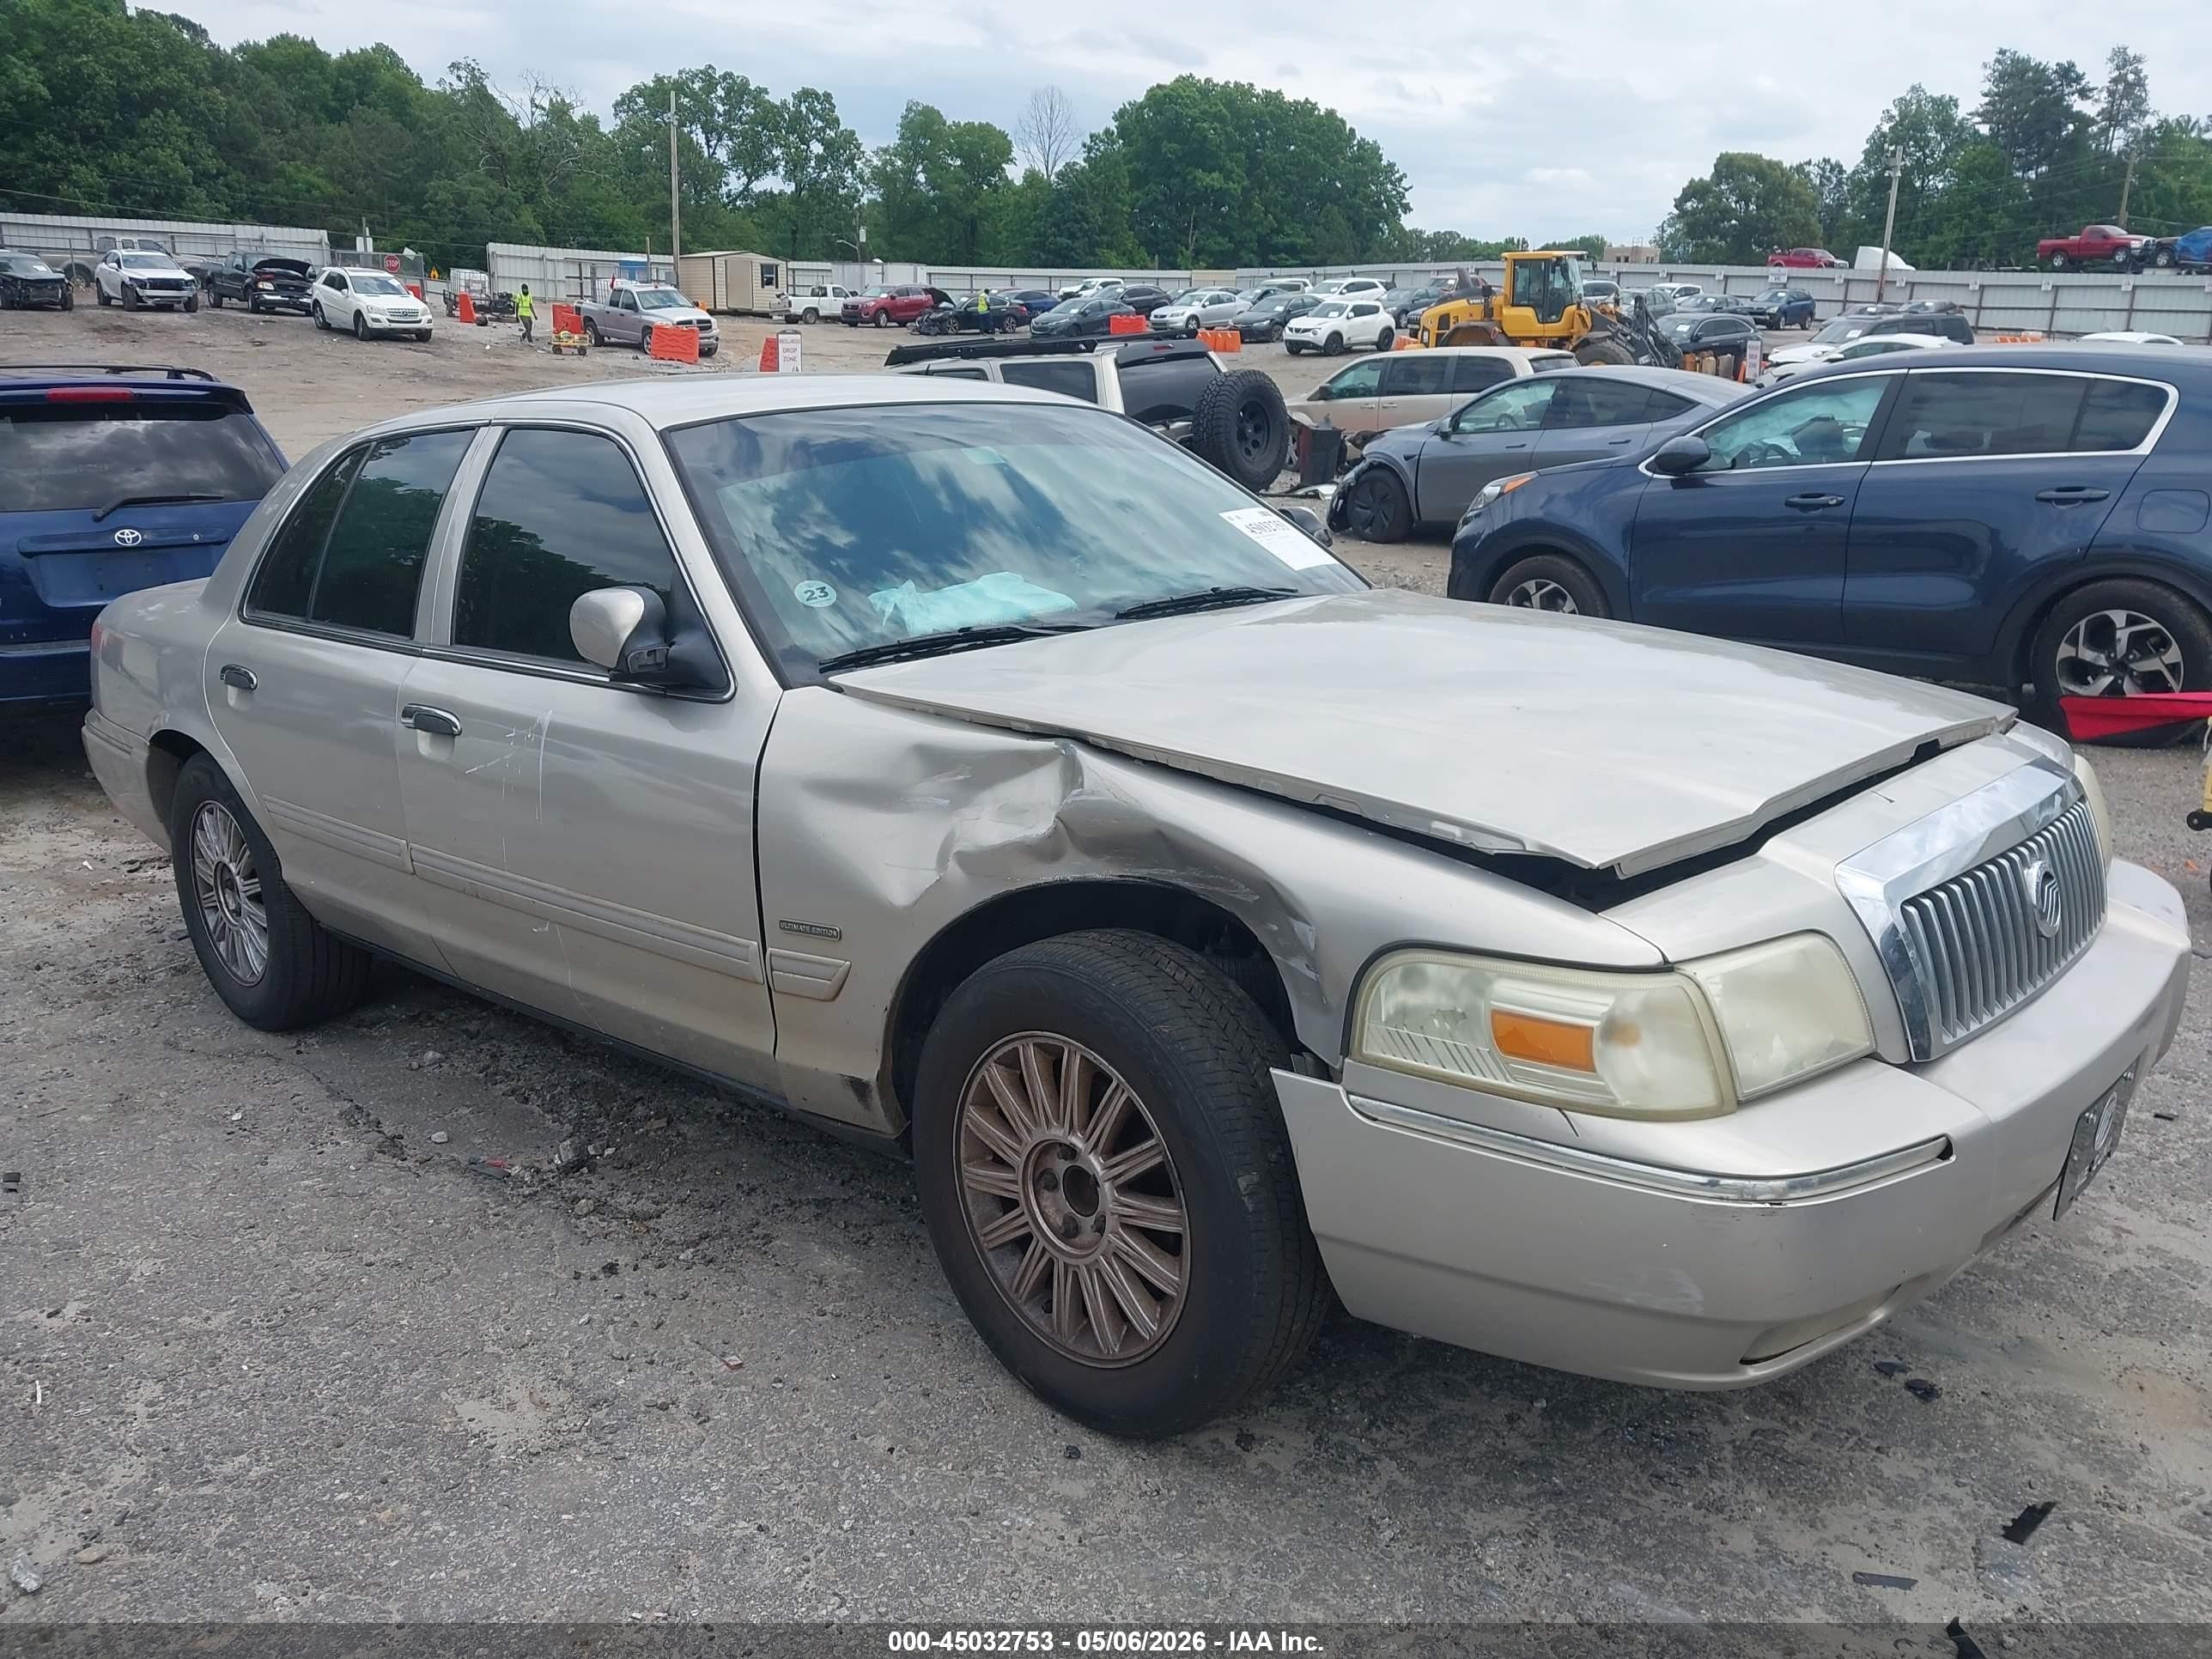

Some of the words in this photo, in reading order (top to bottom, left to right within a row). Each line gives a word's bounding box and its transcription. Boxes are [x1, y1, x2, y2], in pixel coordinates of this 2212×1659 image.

[385, 259, 399, 268] STOP
[803, 586, 830, 601] 23
[811, 927, 837, 937] EDITION
